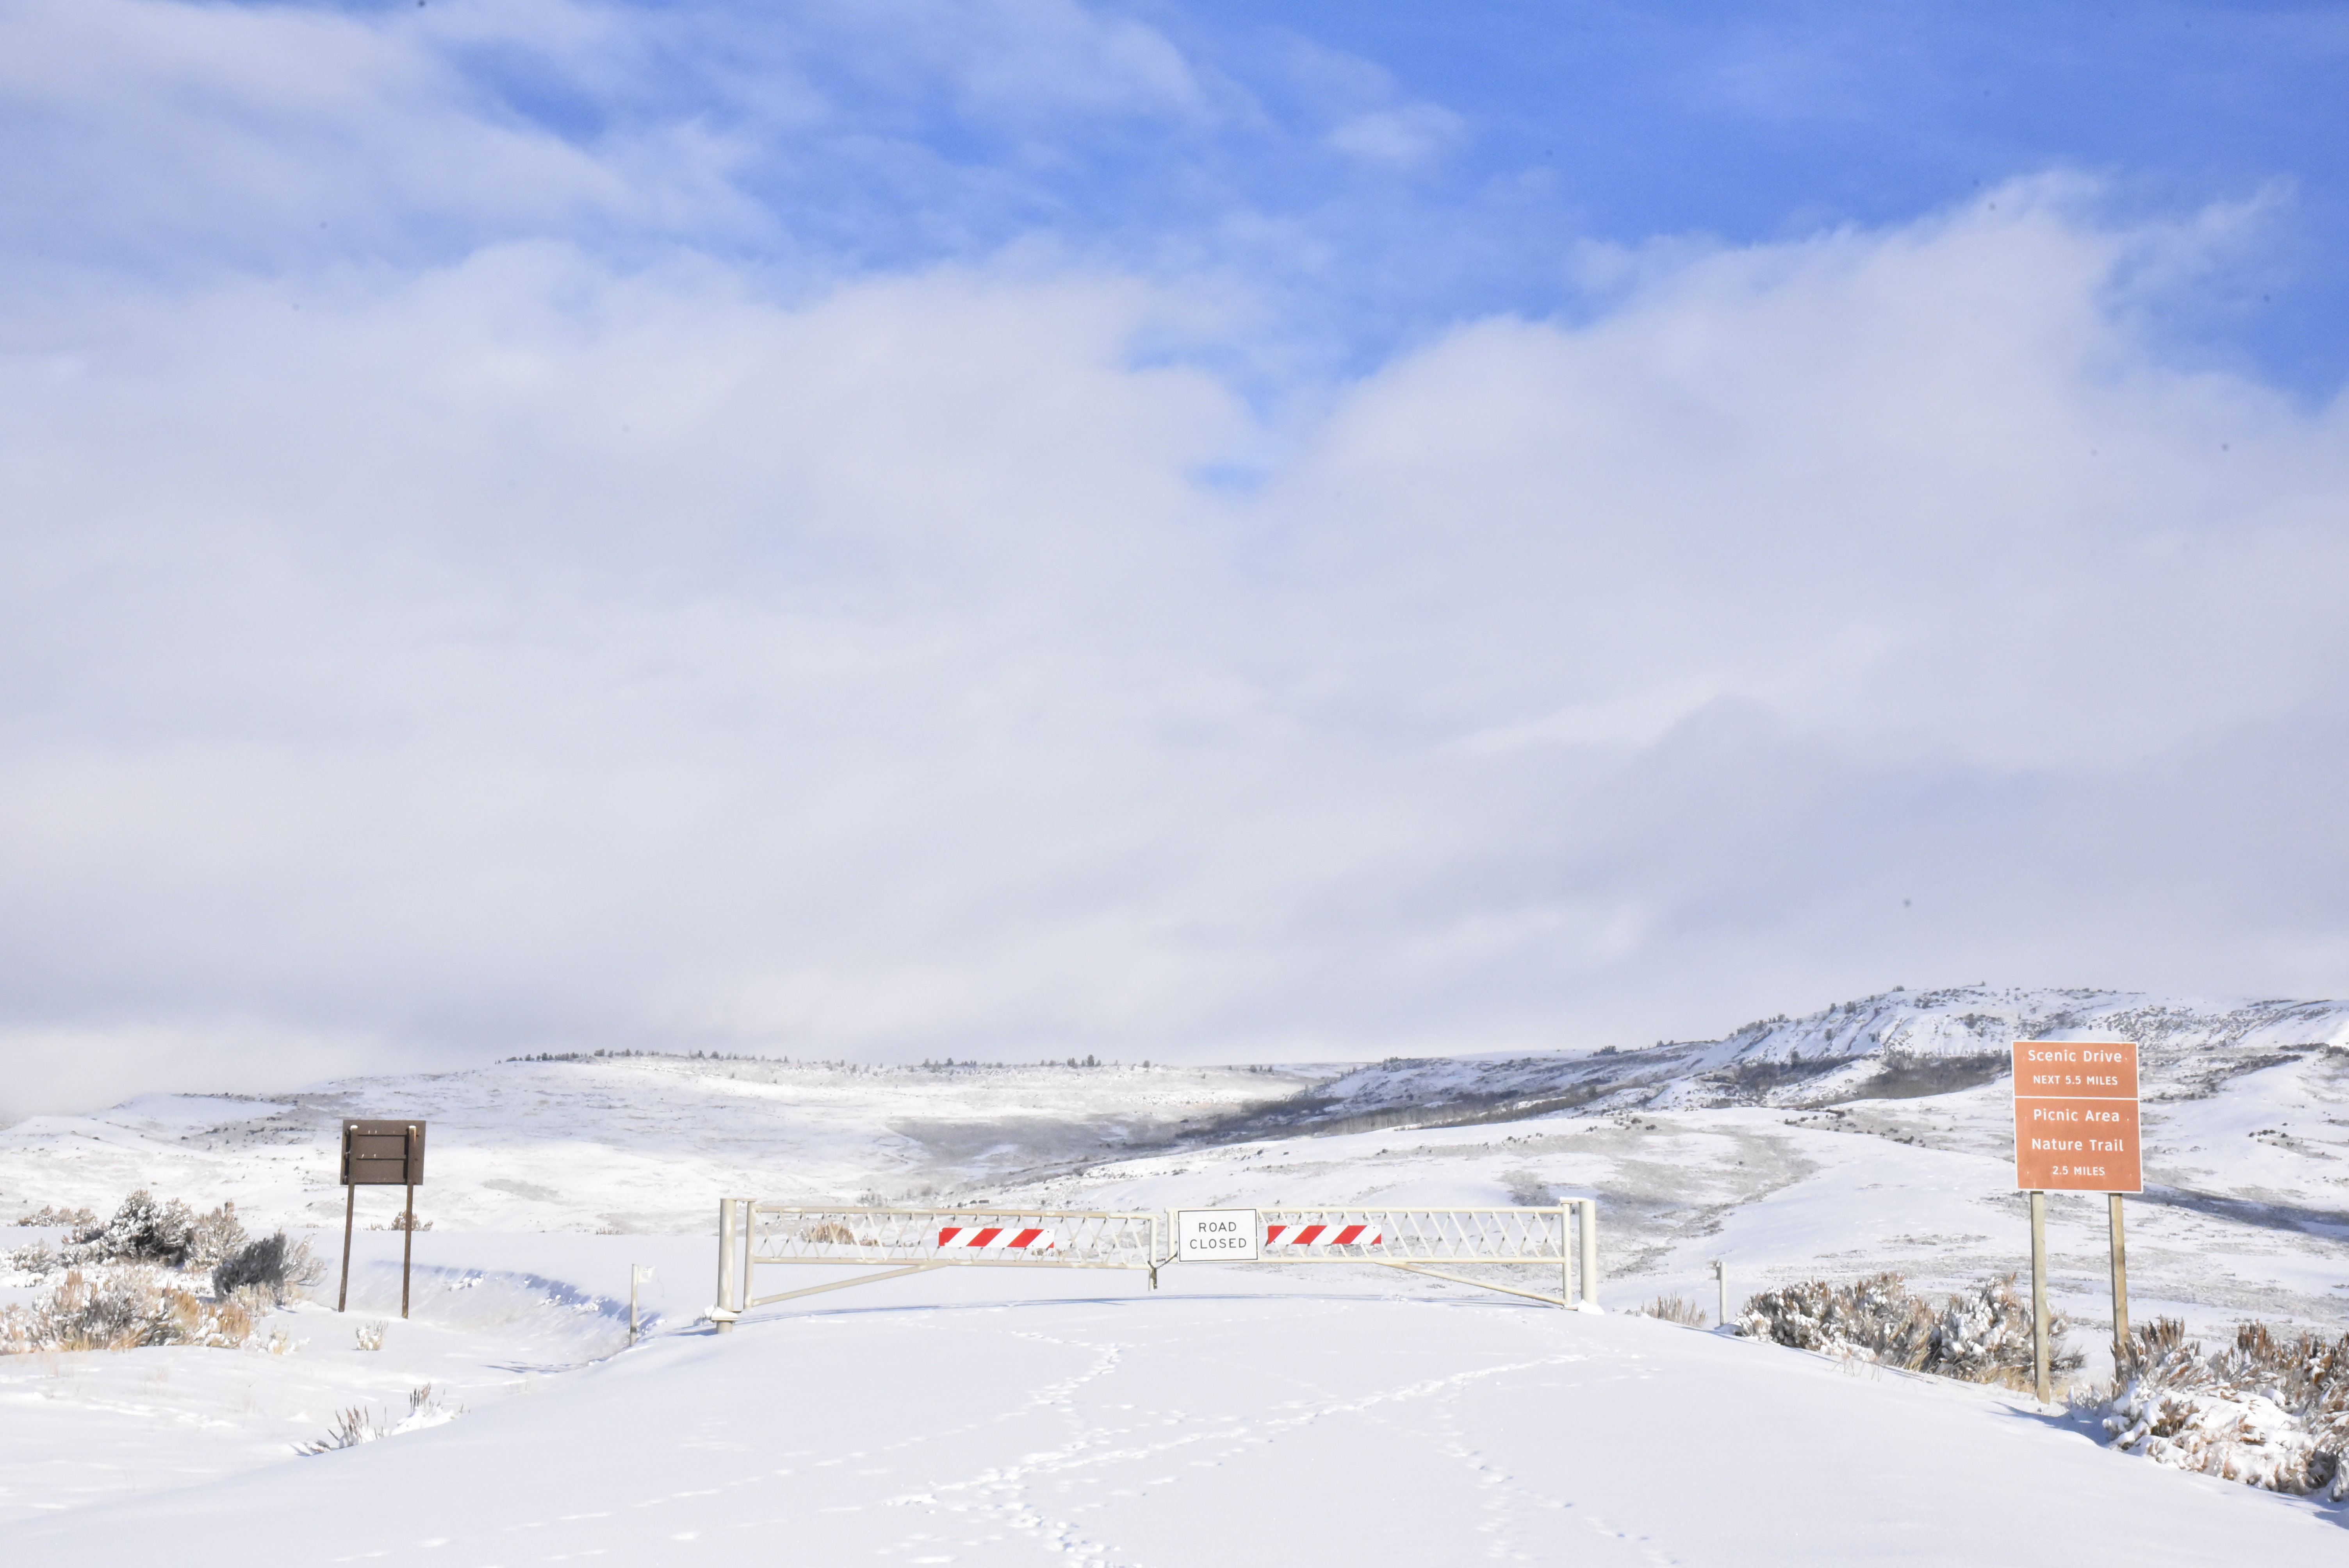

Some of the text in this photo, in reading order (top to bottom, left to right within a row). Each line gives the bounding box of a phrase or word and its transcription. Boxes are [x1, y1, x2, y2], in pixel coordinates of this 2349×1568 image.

[2028, 1049, 2122, 1062] Scenic Drive
[2033, 1075, 2118, 1085] NEXT 5.5 MILES
[2034, 1109, 2119, 1122] Picnic Area
[2032, 1139, 2123, 1151] Nature Trail
[2052, 1166, 2105, 1176] 2.5 MILES
[1199, 1222, 1236, 1232] ROAD
[1190, 1238, 1246, 1249] CLOSED
